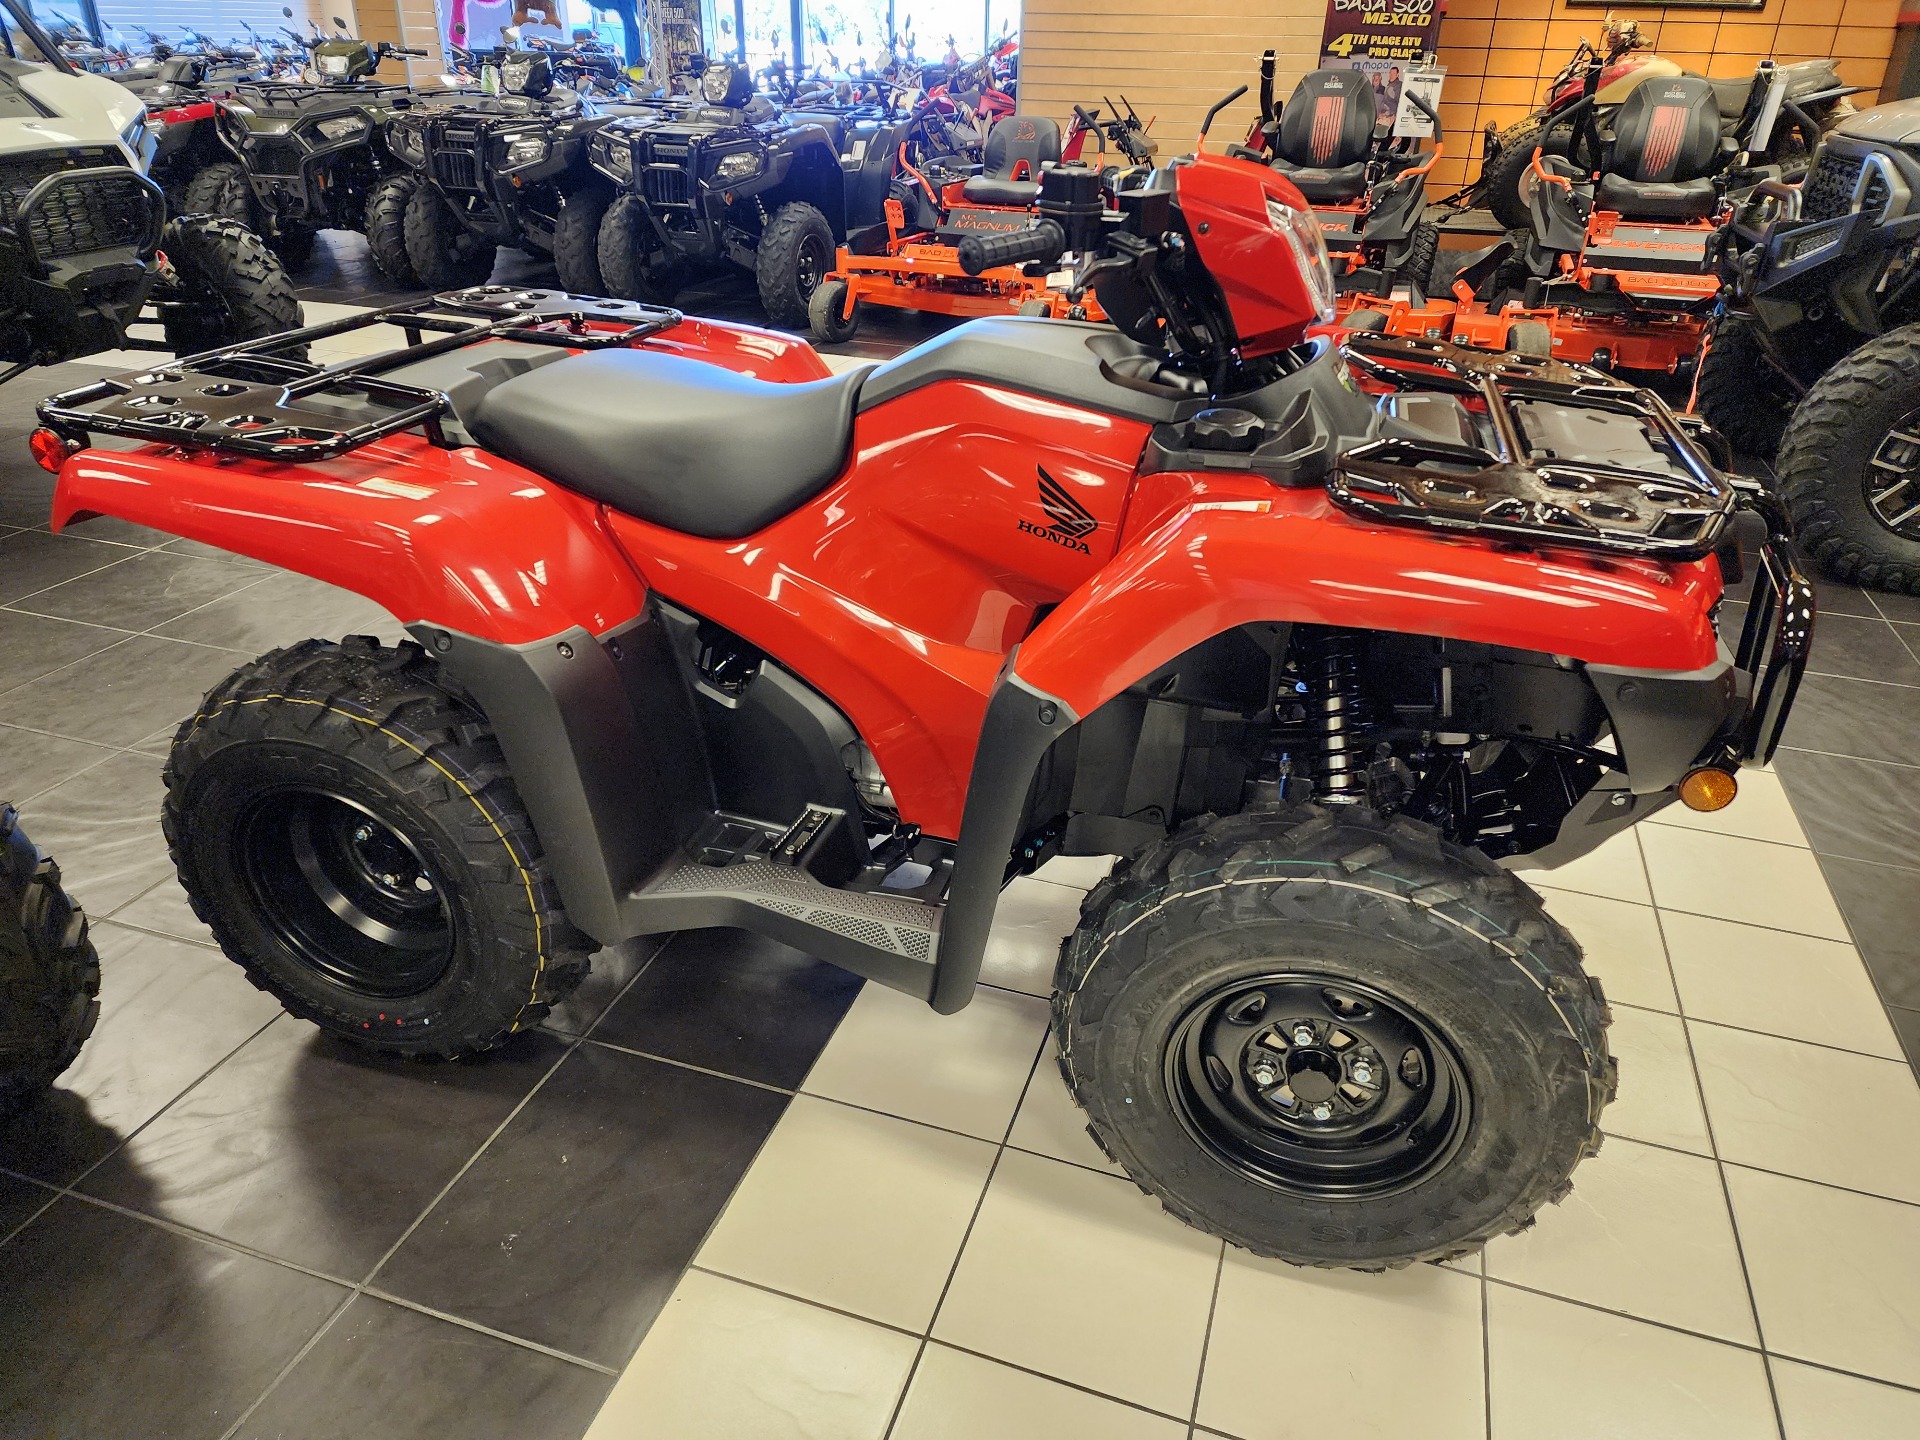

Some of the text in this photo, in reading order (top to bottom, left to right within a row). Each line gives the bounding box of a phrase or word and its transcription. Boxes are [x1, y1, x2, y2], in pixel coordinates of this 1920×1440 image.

[1335, 0, 1434, 13] BAJA 500
[1362, 12, 1431, 26] MEXICO
[1370, 35, 1401, 46] PLACE
[1401, 37, 1422, 46] ATV
[1368, 48, 1389, 57] PRO
[1362, 61, 1393, 71] mopar
[700, 110, 730, 118] RUBICON
[954, 220, 1021, 233] MAGNUM
[1627, 276, 1658, 284] BAD
[1017, 519, 1091, 556] HONDA
